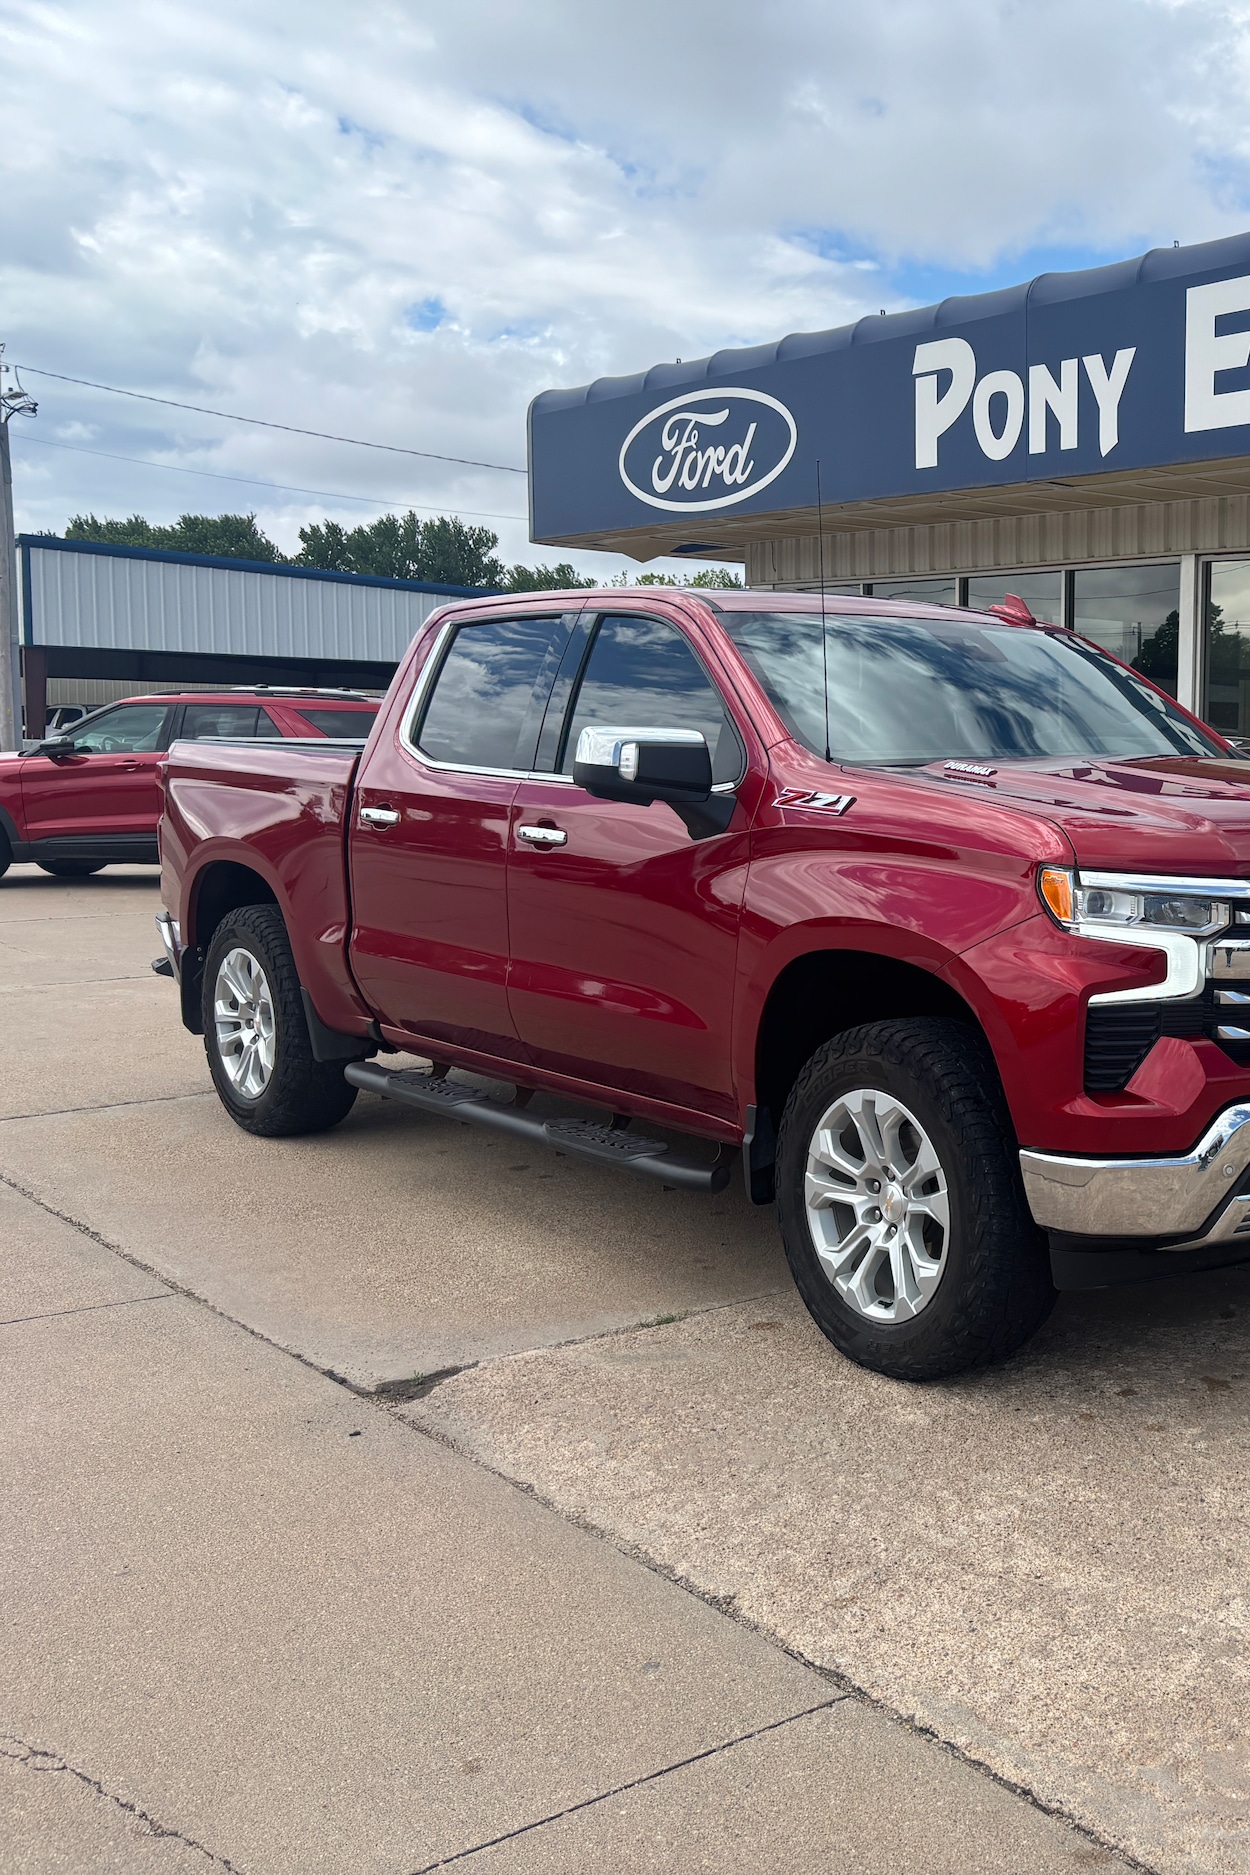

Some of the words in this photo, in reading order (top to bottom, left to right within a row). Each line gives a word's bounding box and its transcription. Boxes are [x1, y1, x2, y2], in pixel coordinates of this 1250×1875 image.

[912, 338, 1136, 469] PONY
[652, 408, 757, 493] Ford
[943, 761, 995, 776] DURAMAX
[771, 787, 856, 815] Z71
[803, 1061, 870, 1104] COOPER
